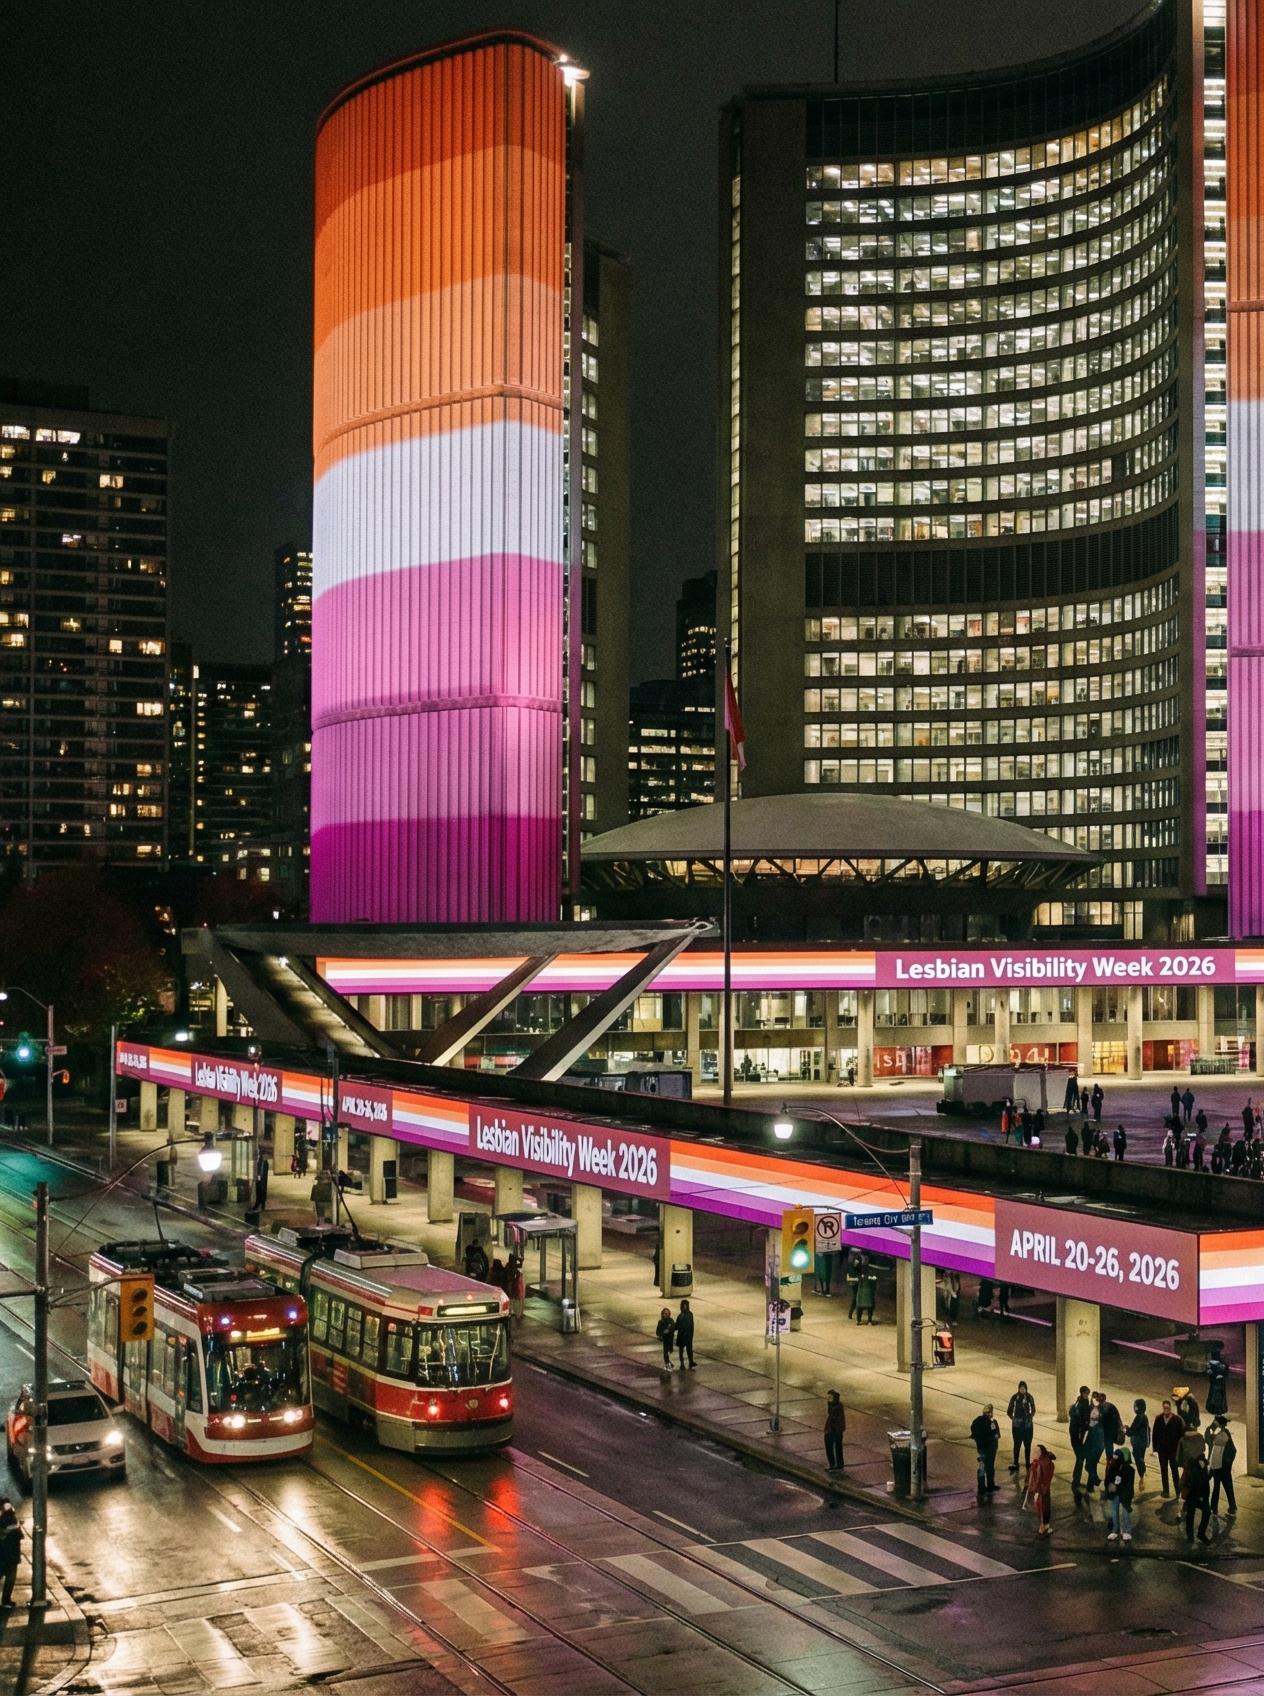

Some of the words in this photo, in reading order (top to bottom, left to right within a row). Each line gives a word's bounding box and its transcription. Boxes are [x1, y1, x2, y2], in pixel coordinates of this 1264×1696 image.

[896, 958, 985, 979] Lesbian
[991, 957, 1087, 982] Visibility
[1092, 956, 1154, 977] Week
[1159, 956, 1216, 977] 2026
[476, 1115, 520, 1157] Lesbian
[521, 1124, 576, 1177] Visibility
[577, 1135, 617, 1177] Week
[618, 1143, 658, 1186] 2026
[1010, 1228, 1061, 1266] APRIL
[1064, 1239, 1124, 1283] 20-26,
[1128, 1252, 1180, 1291] 2026
